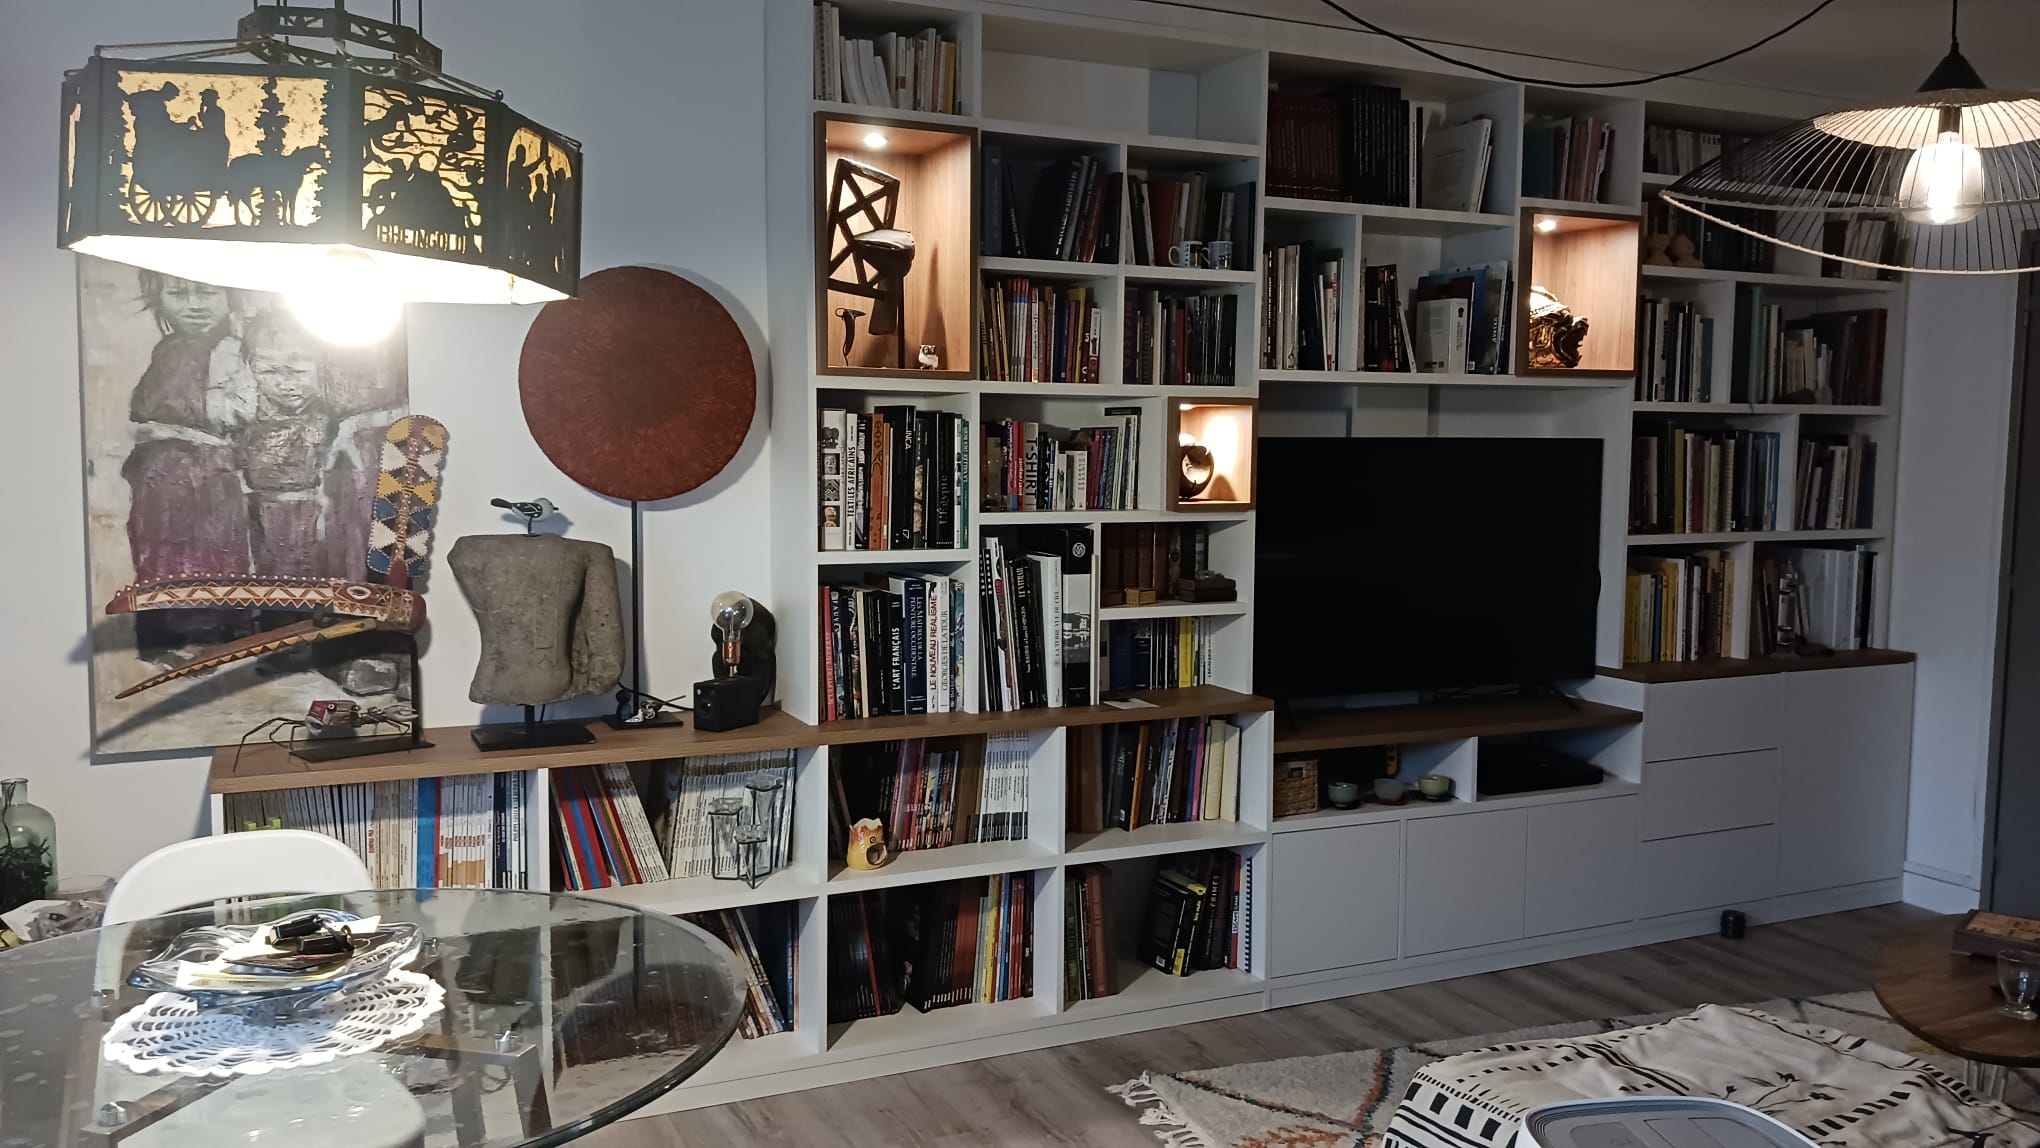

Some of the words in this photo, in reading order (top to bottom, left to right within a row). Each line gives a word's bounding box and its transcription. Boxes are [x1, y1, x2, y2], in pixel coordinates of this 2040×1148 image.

[847, 446, 856, 484] AFRICAINS
[1025, 437, 1038, 499] T-SHIRT
[847, 487, 855, 517] TEXTILES
[891, 627, 902, 666] FRANÇAIS
[929, 639, 937, 678] NOUVEAU
[941, 644, 948, 654] DE
[892, 669, 901, 690] L'ART
[929, 680, 937, 690] LE
